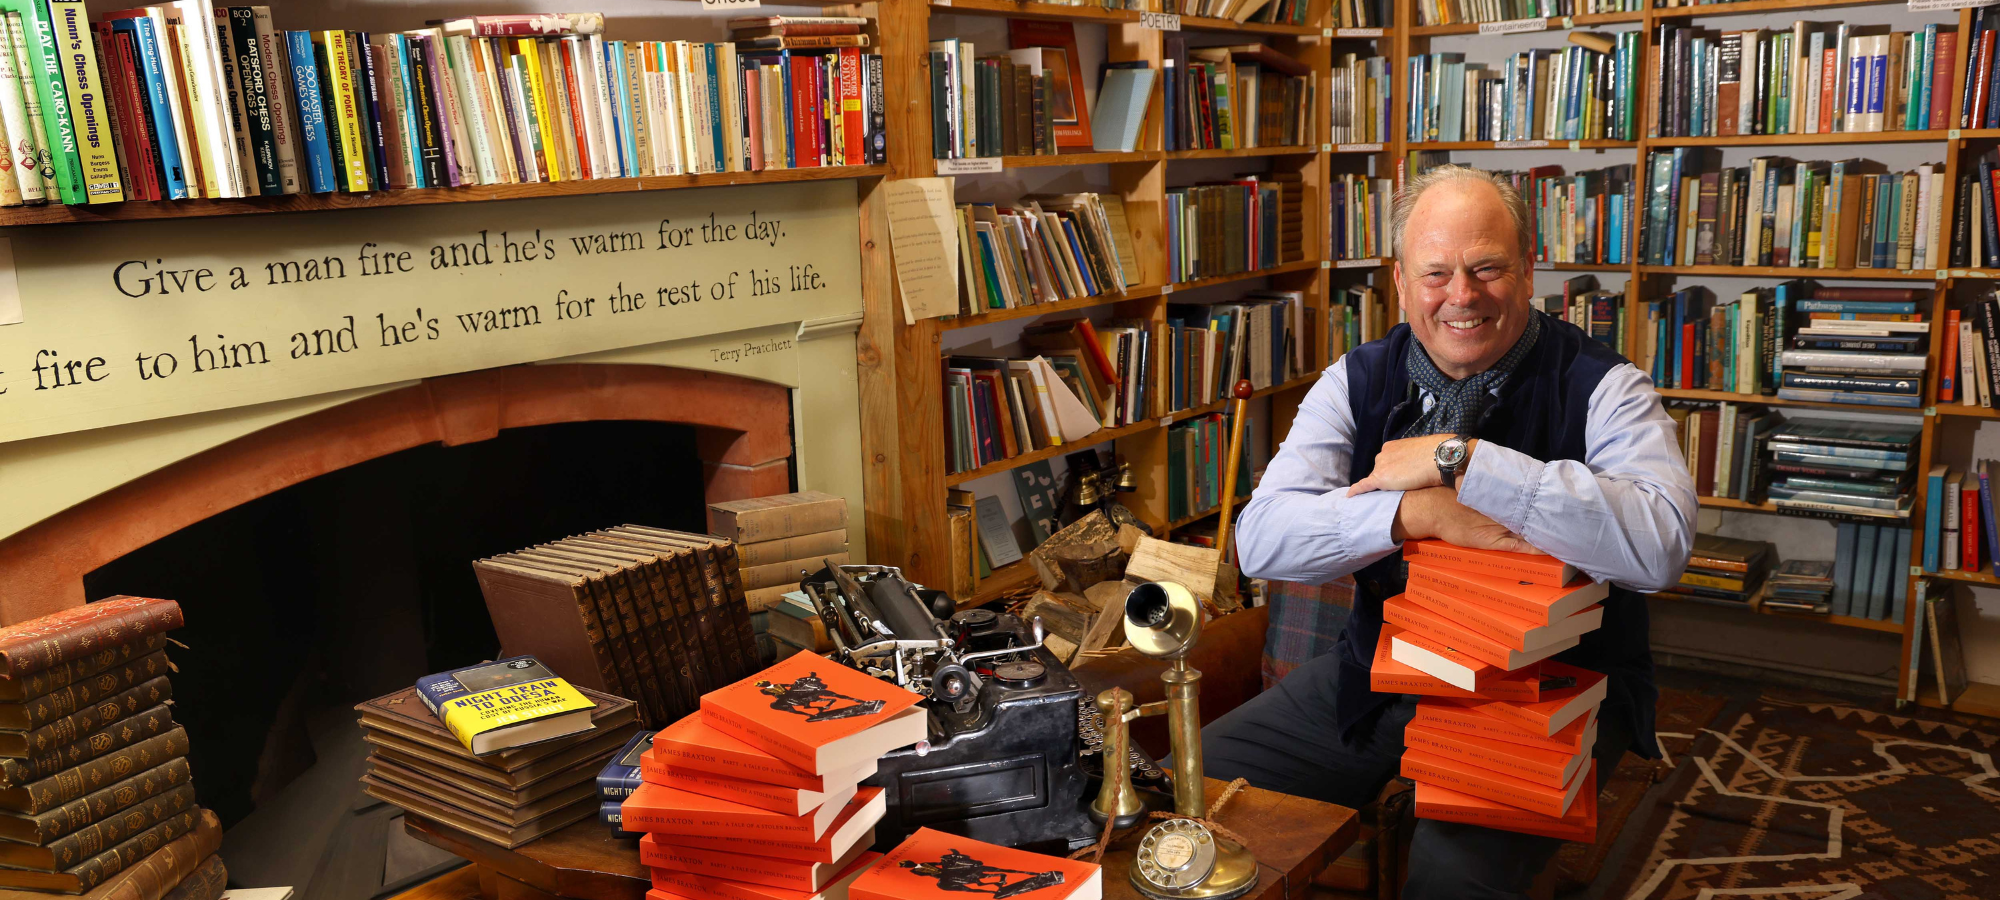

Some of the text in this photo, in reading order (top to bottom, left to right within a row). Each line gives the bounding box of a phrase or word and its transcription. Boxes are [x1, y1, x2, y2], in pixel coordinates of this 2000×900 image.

[233, 9, 252, 26] BCO 2
[1140, 13, 1179, 30] POETRY
[1481, 19, 1546, 32] Mountaineering
[334, 34, 343, 48] THE
[146, 38, 160, 74] King-Hunt
[156, 82, 164, 104] Cozens
[337, 51, 347, 81] THEORY
[391, 62, 399, 76] The
[842, 56, 851, 96] SOLVER
[849, 55, 858, 97] CROSSWORD
[1824, 51, 1834, 91] RAY MEARS
[38, 20, 75, 153] PLAY THE CARO-KANN
[64, 8, 100, 148] Nunn's Chess Openings
[218, 24, 242, 132] Batsford Chess Openings
[241, 55, 257, 108] OPENINGS
[247, 38, 271, 131] BATSFORD CHESS
[342, 83, 350, 92] OF
[875, 59, 883, 114] MASTERMIND
[262, 34, 286, 145] Modern Chess Openings
[305, 65, 322, 124] 500 MASTER
[524, 70, 537, 118] THE TURK
[629, 53, 644, 132] FRENCH DEFENCE
[130, 70, 141, 114] chessboard
[138, 116, 147, 140] magic!
[296, 66, 315, 142] GAMES OF CHESS
[344, 94, 354, 118] POKER
[416, 64, 428, 105] Comprehensive
[424, 121, 433, 147] Openings
[264, 140, 274, 170] KASPAROV
[88, 182, 119, 190] GAMBIT
[113, 210, 786, 298] Give a man fire and he's warm for the day.
[1804, 301, 1843, 312] Pathways
[32, 349, 110, 392] fire
[135, 350, 178, 382] to
[188, 333, 271, 374] him
[290, 315, 359, 360] and
[376, 308, 440, 348] he's
[456, 301, 542, 335] warm
[556, 290, 596, 323] for
[608, 282, 647, 315] the
[656, 279, 702, 309] rest
[710, 271, 739, 301] of
[750, 269, 781, 297] his
[789, 264, 827, 292] life.
[710, 339, 792, 363] Terry Pratchett
[1816, 511, 1846, 519] APART
[1410, 549, 1462, 562] JAMES BRAXTON
[1414, 572, 1459, 590] JAMES BRAXTON
[1388, 610, 1429, 631] JAMES BRAXTON
[455, 692, 505, 709] NIGHT
[509, 680, 558, 698] TRAIN
[1400, 680, 1433, 688] BRAXTON
[471, 689, 557, 711] TO ODESA
[480, 703, 517, 716] COVERING
[534, 695, 560, 704] HUMAN
[480, 712, 500, 720] COST
[514, 702, 548, 713] RUSSIA'S
[550, 698, 567, 706] WAR
[495, 704, 565, 724] JEN STOUT
[704, 708, 742, 730] JAMES BRAXTON
[1422, 715, 1477, 729] JAMES BRAXTON
[660, 747, 716, 763] JAMES BRAXTON
[1410, 736, 1462, 753] JAMES BRAXTON
[646, 766, 698, 783] JAMES BRAXTON
[1407, 766, 1460, 783] JAMES BRAXTON
[604, 787, 637, 796] NIGHT TRA
[608, 814, 622, 822] NIGH
[630, 815, 654, 823] JAMES
[655, 817, 694, 825] BRAXTON
[646, 851, 703, 866] JAMES BRAXTON
[875, 840, 919, 876] JAMES BRAXTON
